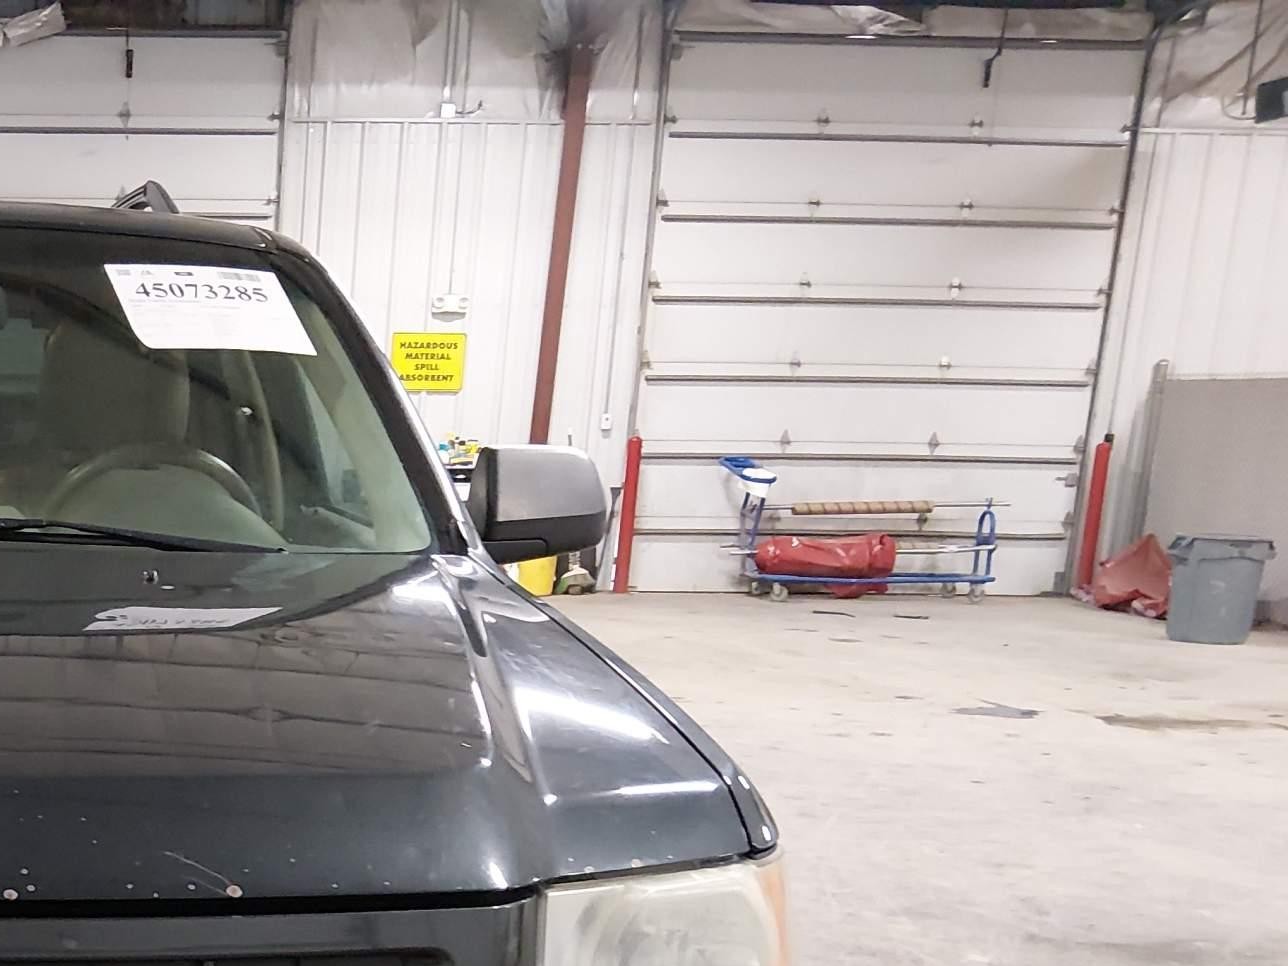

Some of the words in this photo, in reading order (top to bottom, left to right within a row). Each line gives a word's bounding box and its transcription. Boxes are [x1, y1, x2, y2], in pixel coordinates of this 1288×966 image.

[135, 282, 269, 303] 45073285
[399, 341, 459, 350] HAZARDOUS
[404, 352, 453, 361] MATERIAL
[414, 363, 441, 371] SPILL
[399, 374, 455, 382] ABSORBENT
